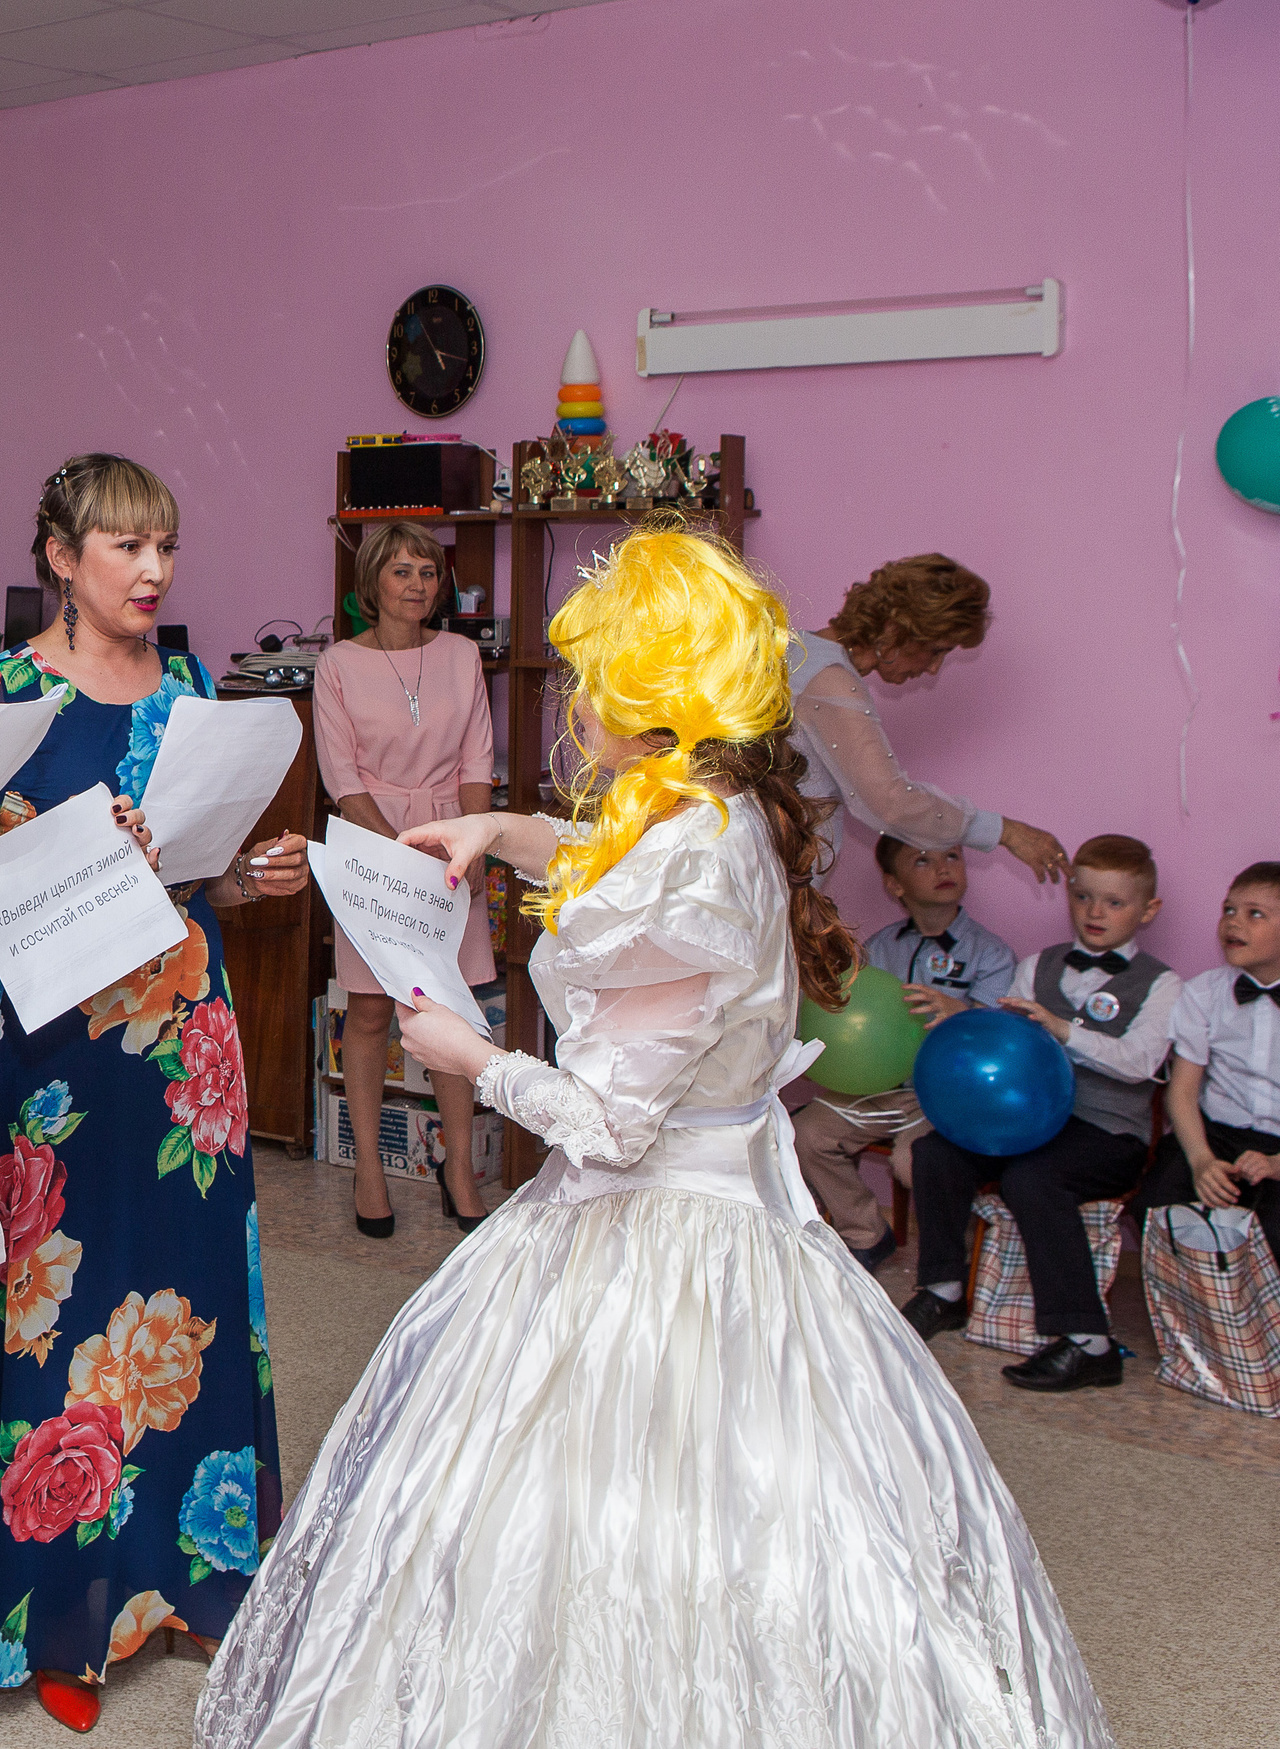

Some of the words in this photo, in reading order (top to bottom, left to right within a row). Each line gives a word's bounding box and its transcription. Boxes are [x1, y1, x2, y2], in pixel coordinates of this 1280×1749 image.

[428, 289, 438, 303] 12
[407, 301, 415, 315] 11
[393, 323, 404, 338] 10
[466, 317, 474, 331] 2
[471, 341, 478, 356] 3
[395, 370, 402, 385] 8
[466, 365, 473, 380] 4
[409, 391, 416, 406] 7
[454, 388, 461, 403] 5
[431, 399, 438, 415] 6
[50, 864, 94, 898] цыплят
[95, 840, 133, 873] зимой
[344, 858, 380, 884] «Поди
[382, 874, 410, 898] туда,
[413, 887, 427, 901] не
[428, 893, 454, 913] знаю
[9, 943, 20, 957] и
[20, 907, 78, 950] сосчитай
[77, 900, 95, 917] по
[94, 874, 139, 907] весне!»
[342, 889, 368, 910] куда.
[370, 898, 417, 930] Принеси
[418, 920, 431, 939] то,
[433, 927, 446, 941] не
